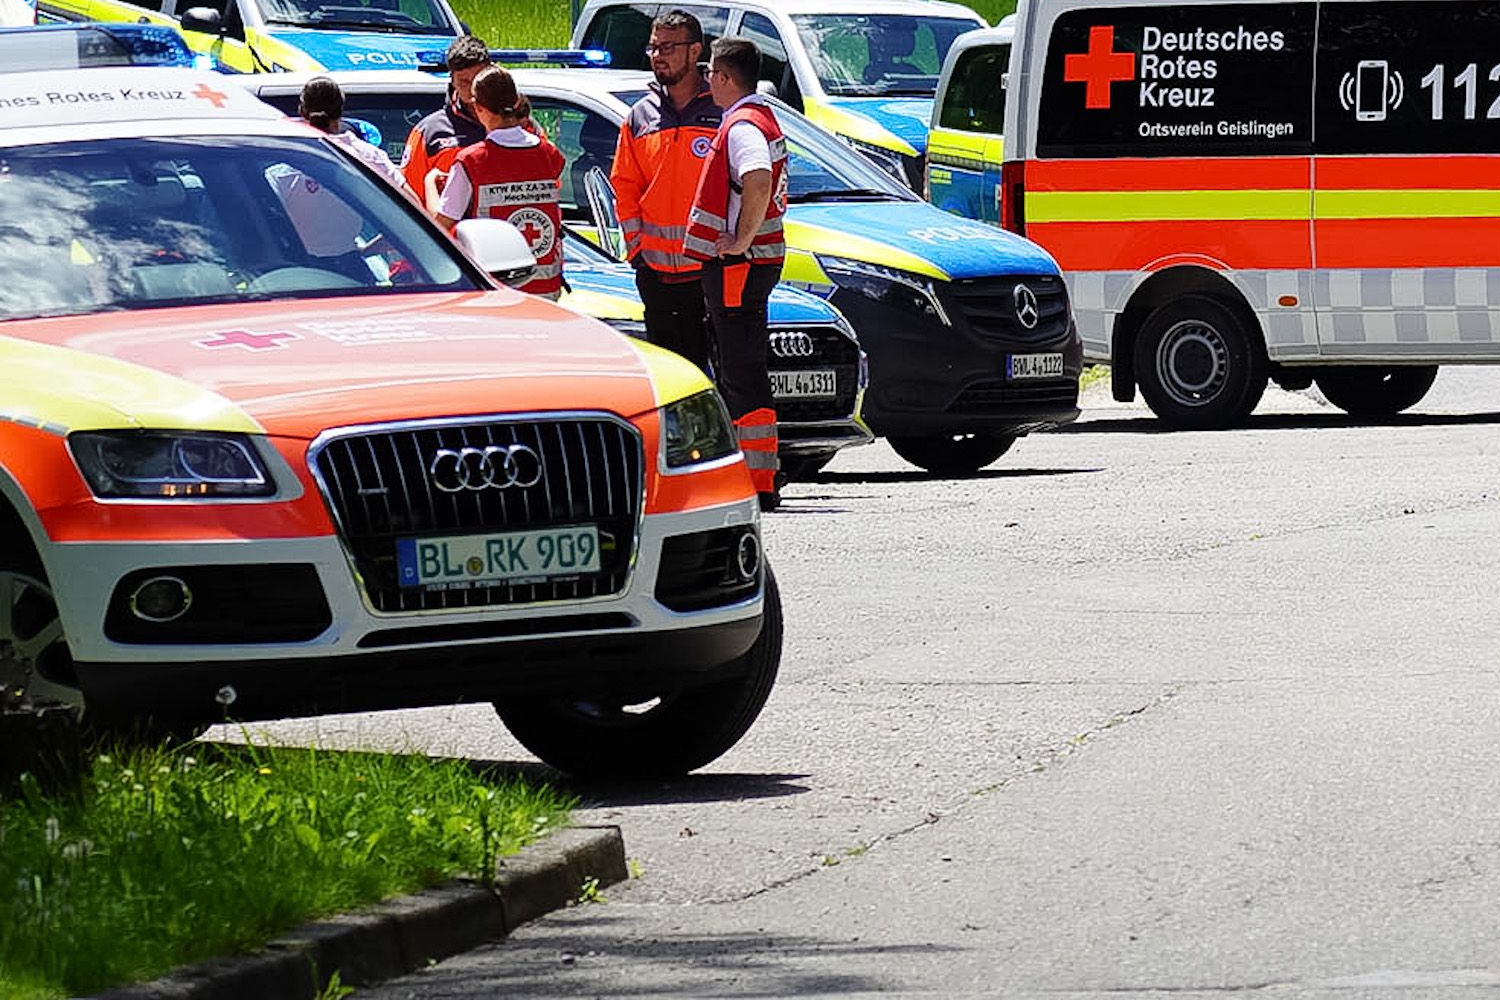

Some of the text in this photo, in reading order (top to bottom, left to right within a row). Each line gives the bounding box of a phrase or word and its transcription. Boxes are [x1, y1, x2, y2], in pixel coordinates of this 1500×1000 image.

[1142, 25, 1285, 51] Deutsches
[345, 52, 420, 66] POLI
[1140, 54, 1218, 79] Rotes
[46, 91, 114, 106] Rotes
[119, 88, 187, 102] Kreuz
[1139, 82, 1215, 107] Kreuz
[1138, 119, 1294, 139] Ortsverein Geislingen
[419, 542, 464, 578] BL
[485, 536, 529, 574] RK
[536, 532, 595, 569] 909
